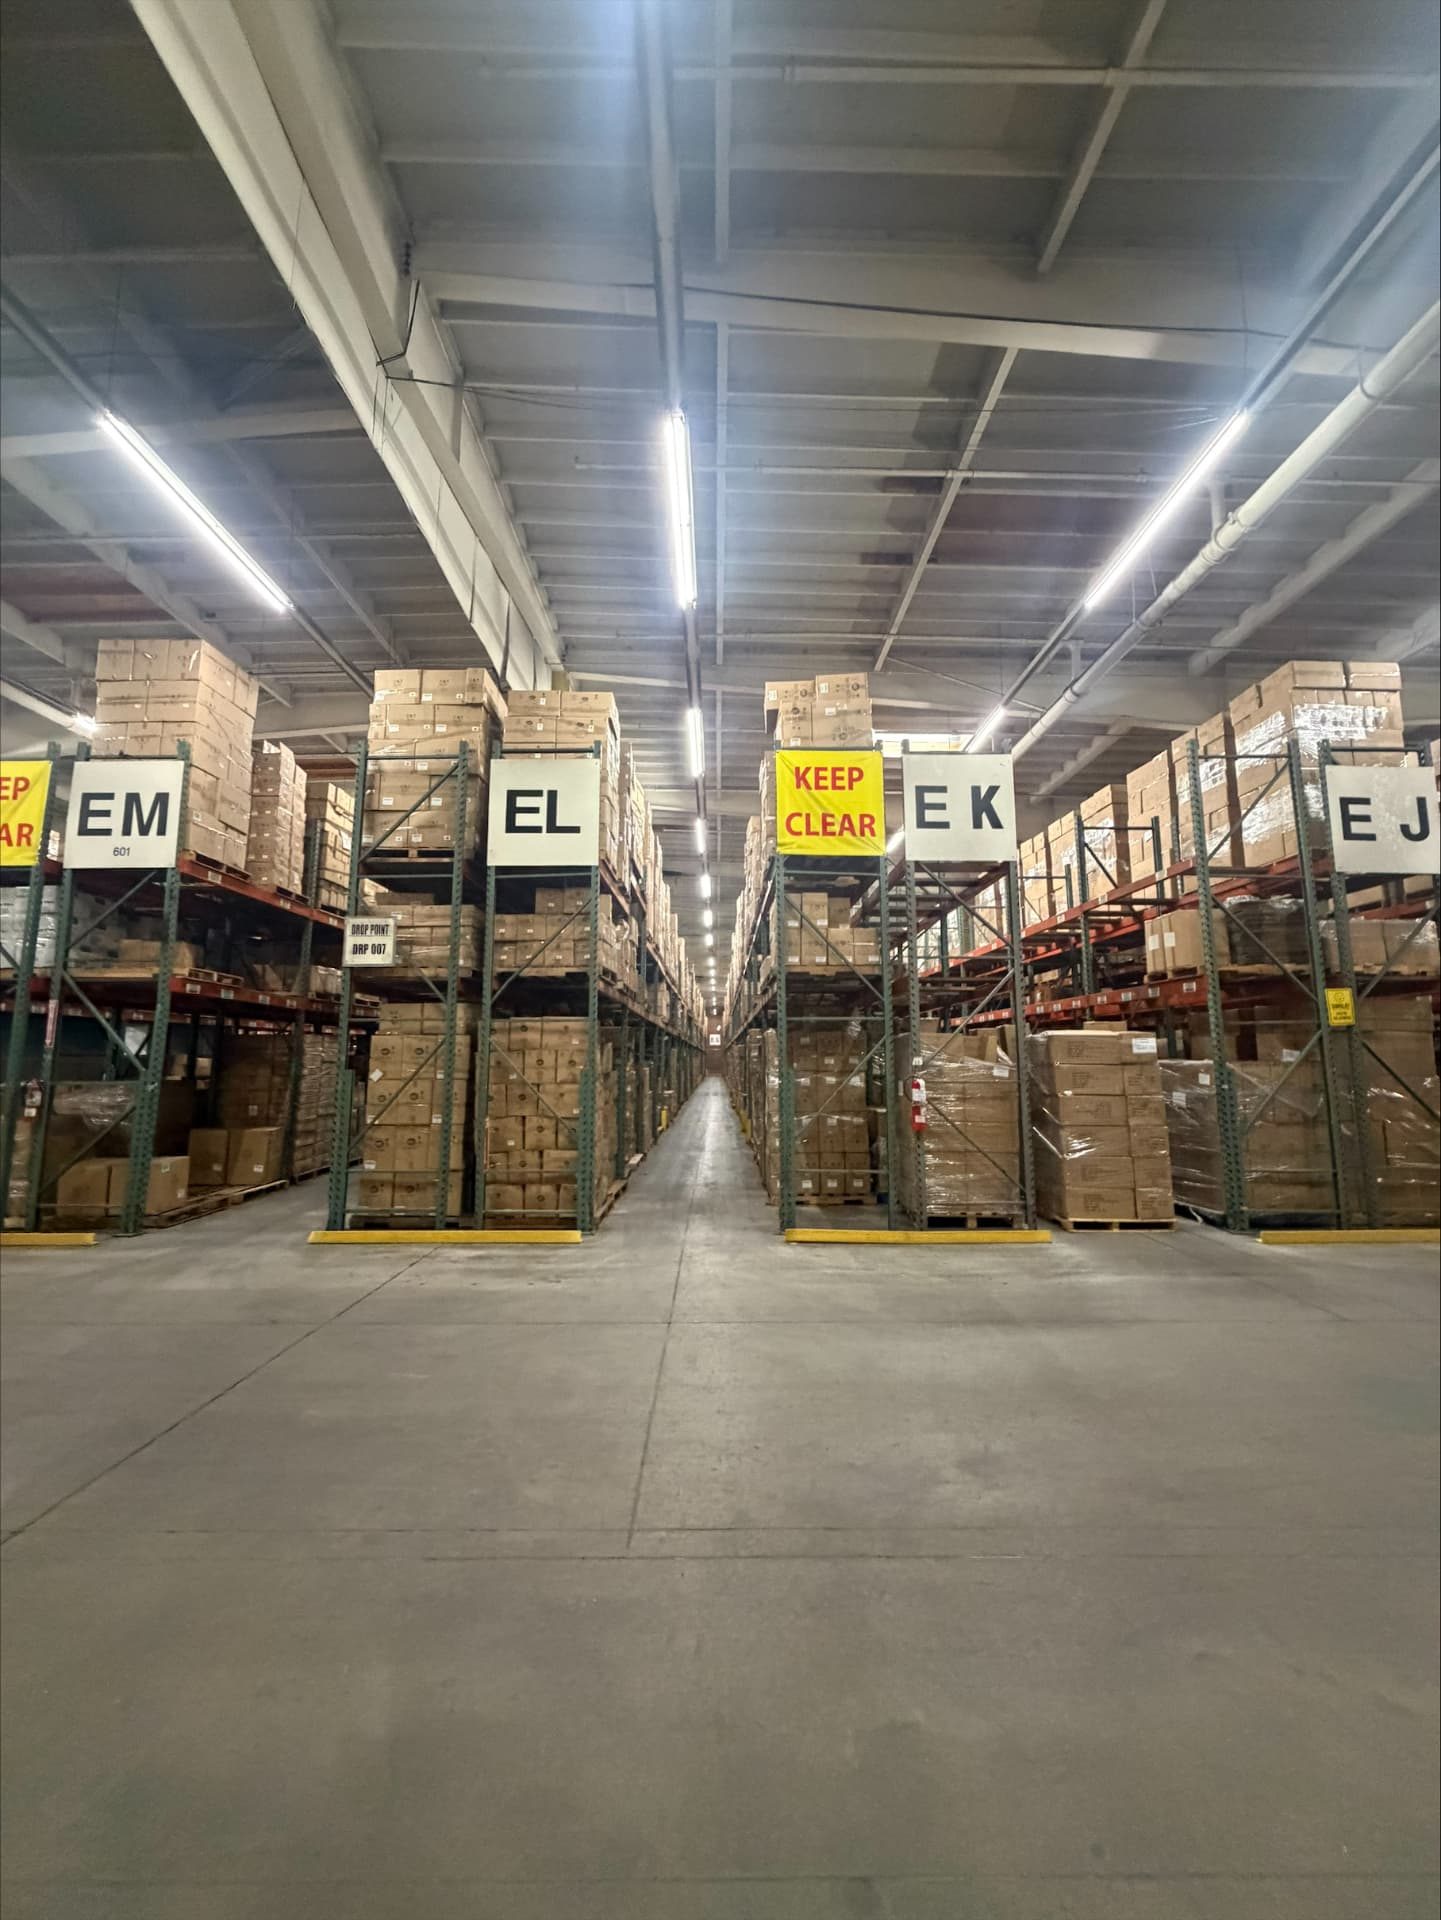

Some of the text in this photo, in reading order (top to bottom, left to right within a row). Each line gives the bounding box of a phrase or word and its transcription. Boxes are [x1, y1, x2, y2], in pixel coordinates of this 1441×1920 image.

[794, 766, 864, 791] KEEP
[77, 792, 170, 836] EM
[505, 789, 581, 834] EL
[785, 812, 876, 837] CLEAR
[113, 847, 131, 857] 601
[352, 924, 389, 936] DROP POINT
[371, 943, 386, 955] 007
